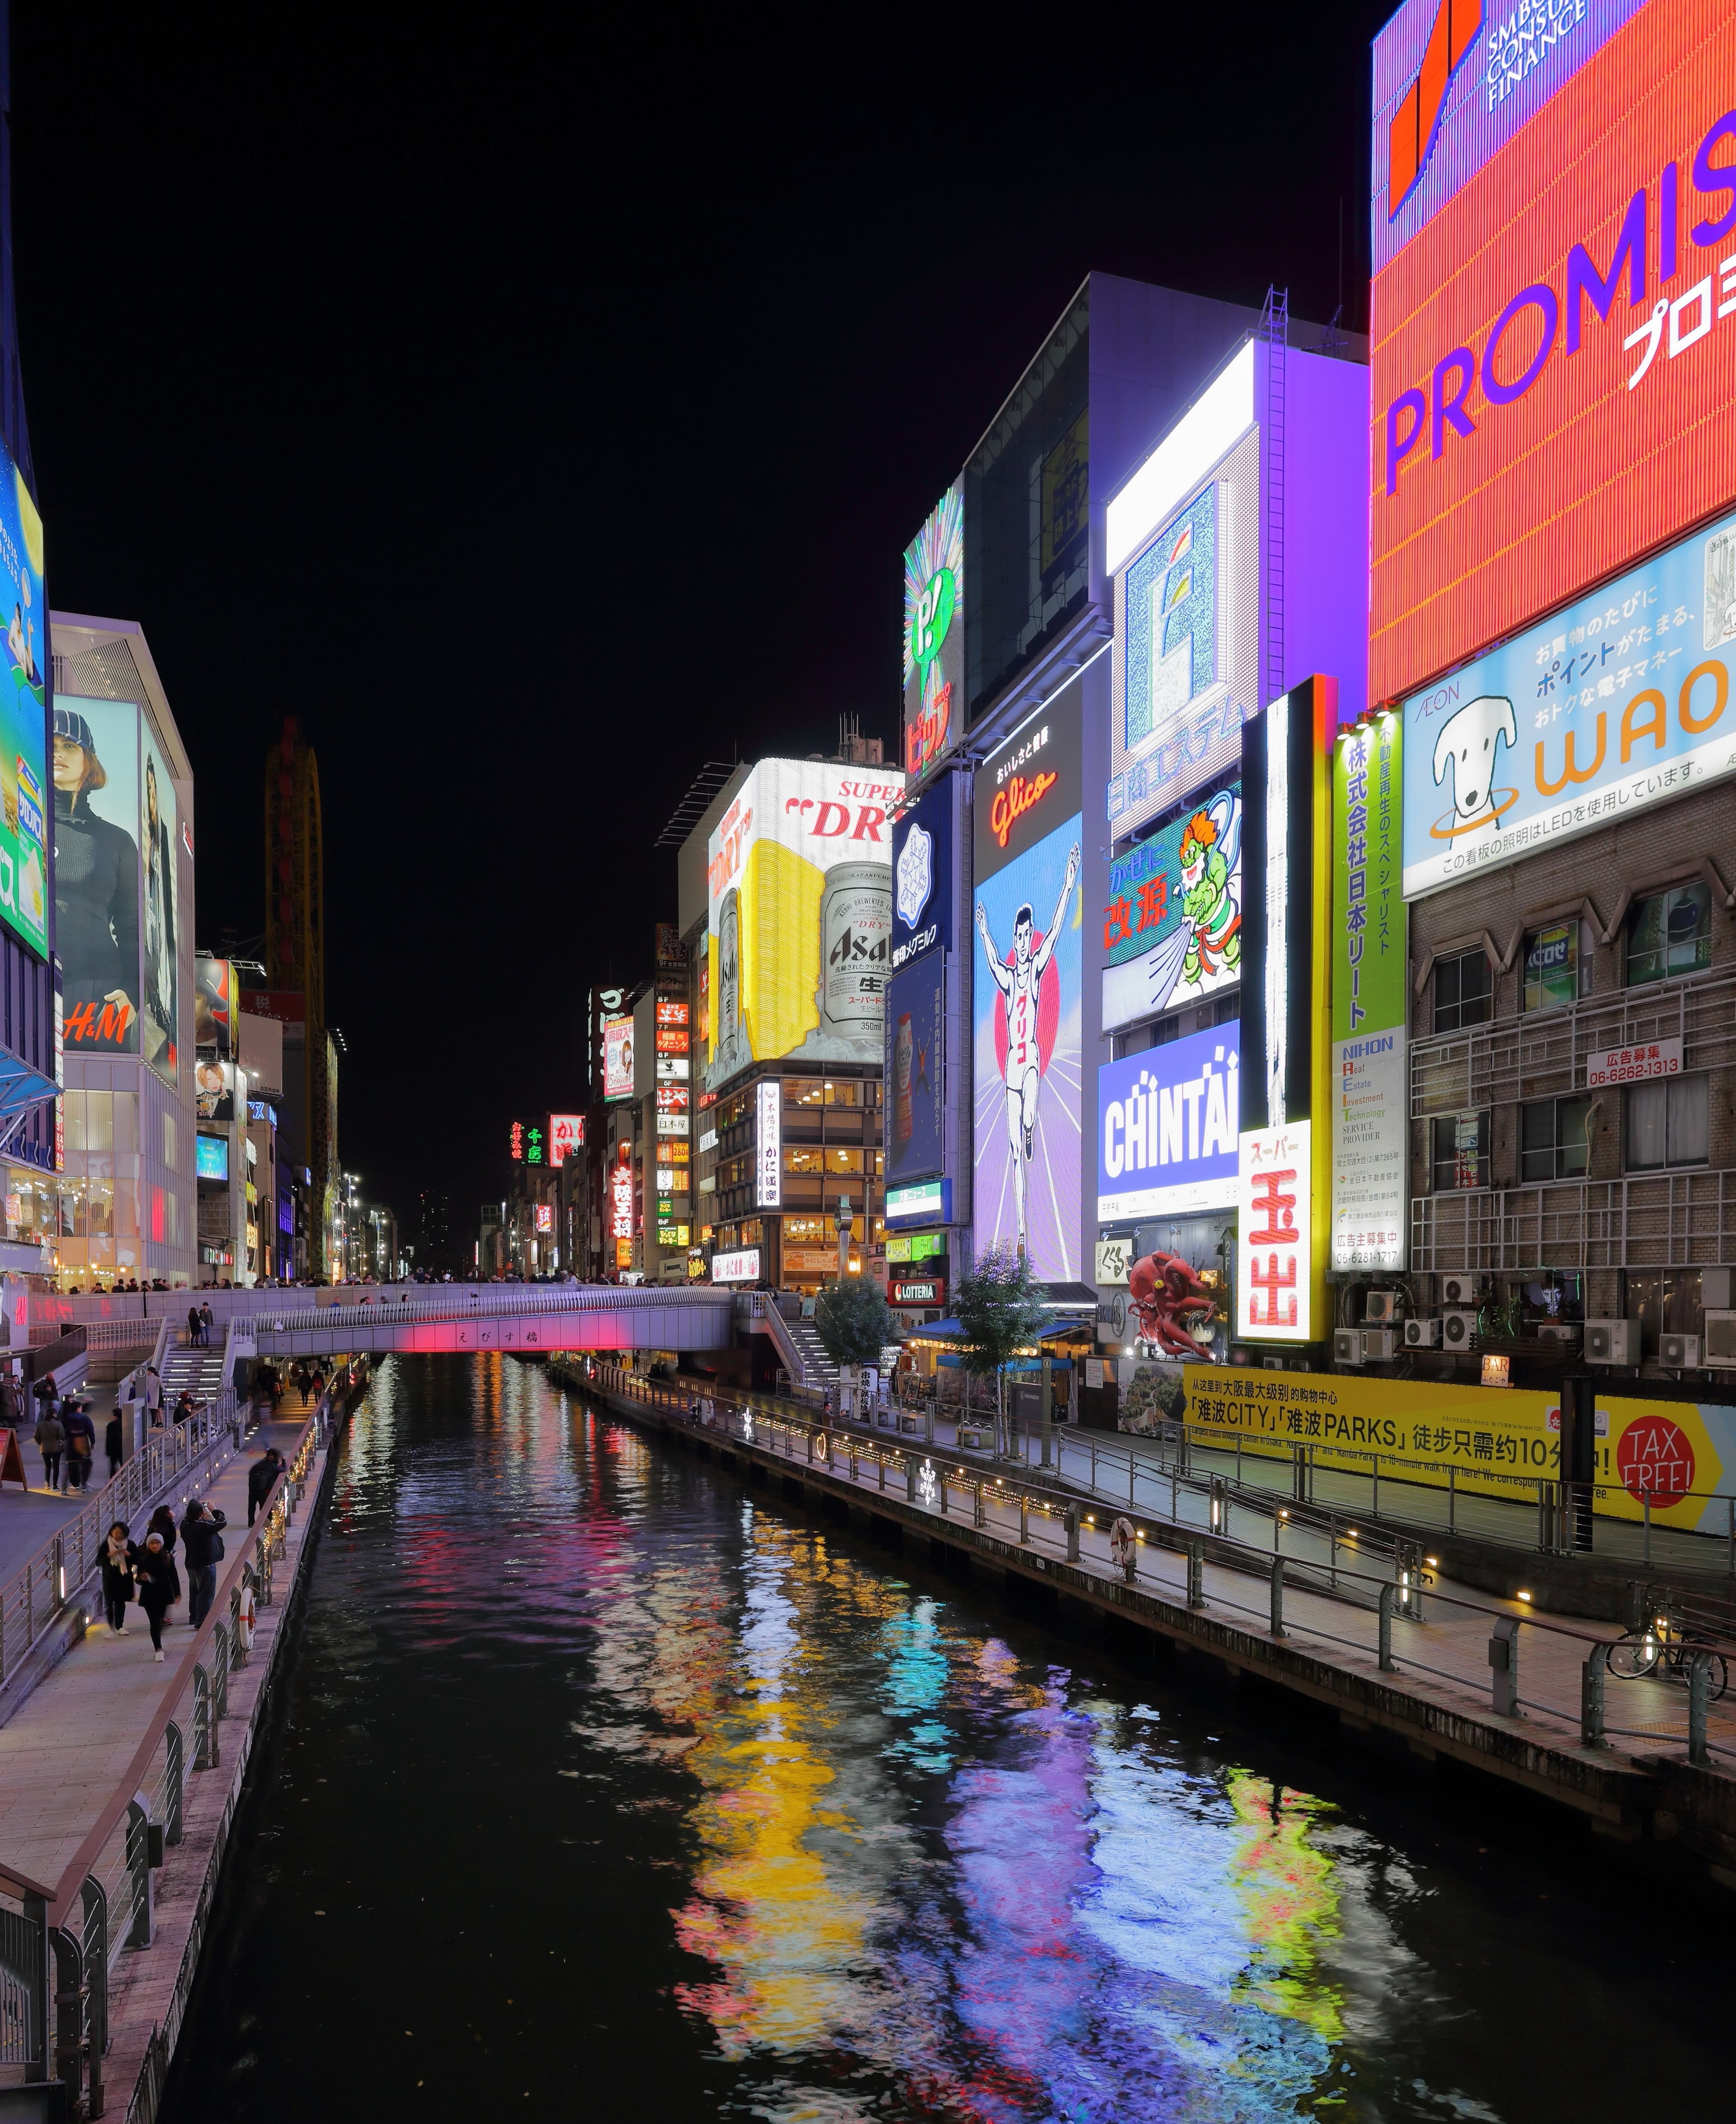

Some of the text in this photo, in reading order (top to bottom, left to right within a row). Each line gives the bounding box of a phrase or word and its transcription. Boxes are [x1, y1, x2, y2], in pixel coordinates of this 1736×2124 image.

[1487, 0, 1573, 84] CONSU
[1488, 0, 1586, 112] FINANCE
[1535, 585, 1658, 666] お買物のたびに
[1536, 605, 1695, 698] ポイントがたまる、
[1535, 646, 1683, 729] おトクな電子マネー
[907, 681, 952, 773] ピップ
[19, 791, 43, 842] サロンパス
[785, 797, 897, 843] “DR
[992, 772, 1057, 847] Glico
[1444, 761, 1703, 874] この看板の照明はLEDを使用しています。
[1379, 727, 1391, 956] 不動産再生のスペシャリスト
[1110, 843, 1167, 895] かぜに
[1347, 740, 1367, 1031] 株式会社日本リート
[840, 904, 853, 918] ASAHI
[854, 898, 884, 907] BREWERIES
[1103, 872, 1170, 949] 改源
[892, 924, 937, 968] 雪印メグミルク
[859, 977, 883, 993] 生
[64, 1002, 130, 1044] H&M
[861, 1022, 881, 1031] 350ml
[1016, 989, 1028, 1064] グリコ
[658, 1041, 688, 1050] ダイニング
[1343, 1036, 1393, 1061] NIHON
[1606, 1045, 1661, 1067] 広告募集
[1343, 1062, 1364, 1076] Real
[1590, 1059, 1679, 1085] 06-6262-1313
[1343, 1077, 1371, 1091] Estate
[1343, 1093, 1383, 1107] Investment
[660, 1118, 686, 1129] 白木屋
[1342, 1107, 1385, 1122] Technology
[1342, 1121, 1374, 1135] SERVICE
[1343, 1131, 1380, 1144] PROVIDER
[528, 1128, 542, 1159] 千房
[674, 1148, 688, 1156] 280円
[765, 1102, 777, 1201] 本場の味 かに道楽
[1250, 1135, 1299, 1164] スーパー
[1337, 1152, 1399, 1168] 国土交通大臣(2)第7265号
[1349, 1172, 1398, 1184] 全日本不動産協会
[612, 1166, 631, 1238] 大阪王将
[1337, 1192, 1398, 1204] 近畿財務局長(金商)第84号
[1249, 1168, 1299, 1327] 玉出
[1337, 1231, 1396, 1248] 広告主募集中
[1337, 1252, 1397, 1264] 06-6281-1717
[902, 1285, 934, 1299] LOTTERIA
[459, 1331, 538, 1343] えびす橋
[1482, 1358, 1508, 1372] BAR
[1192, 1378, 1338, 1405] 从这里到大阪最大级别的购物中心
[1483, 1375, 1505, 1384] ふたごや
[1628, 1426, 1679, 1461] TAX
[1497, 1474, 1542, 1490] correspon
[1623, 1460, 1691, 1495] FREE!
